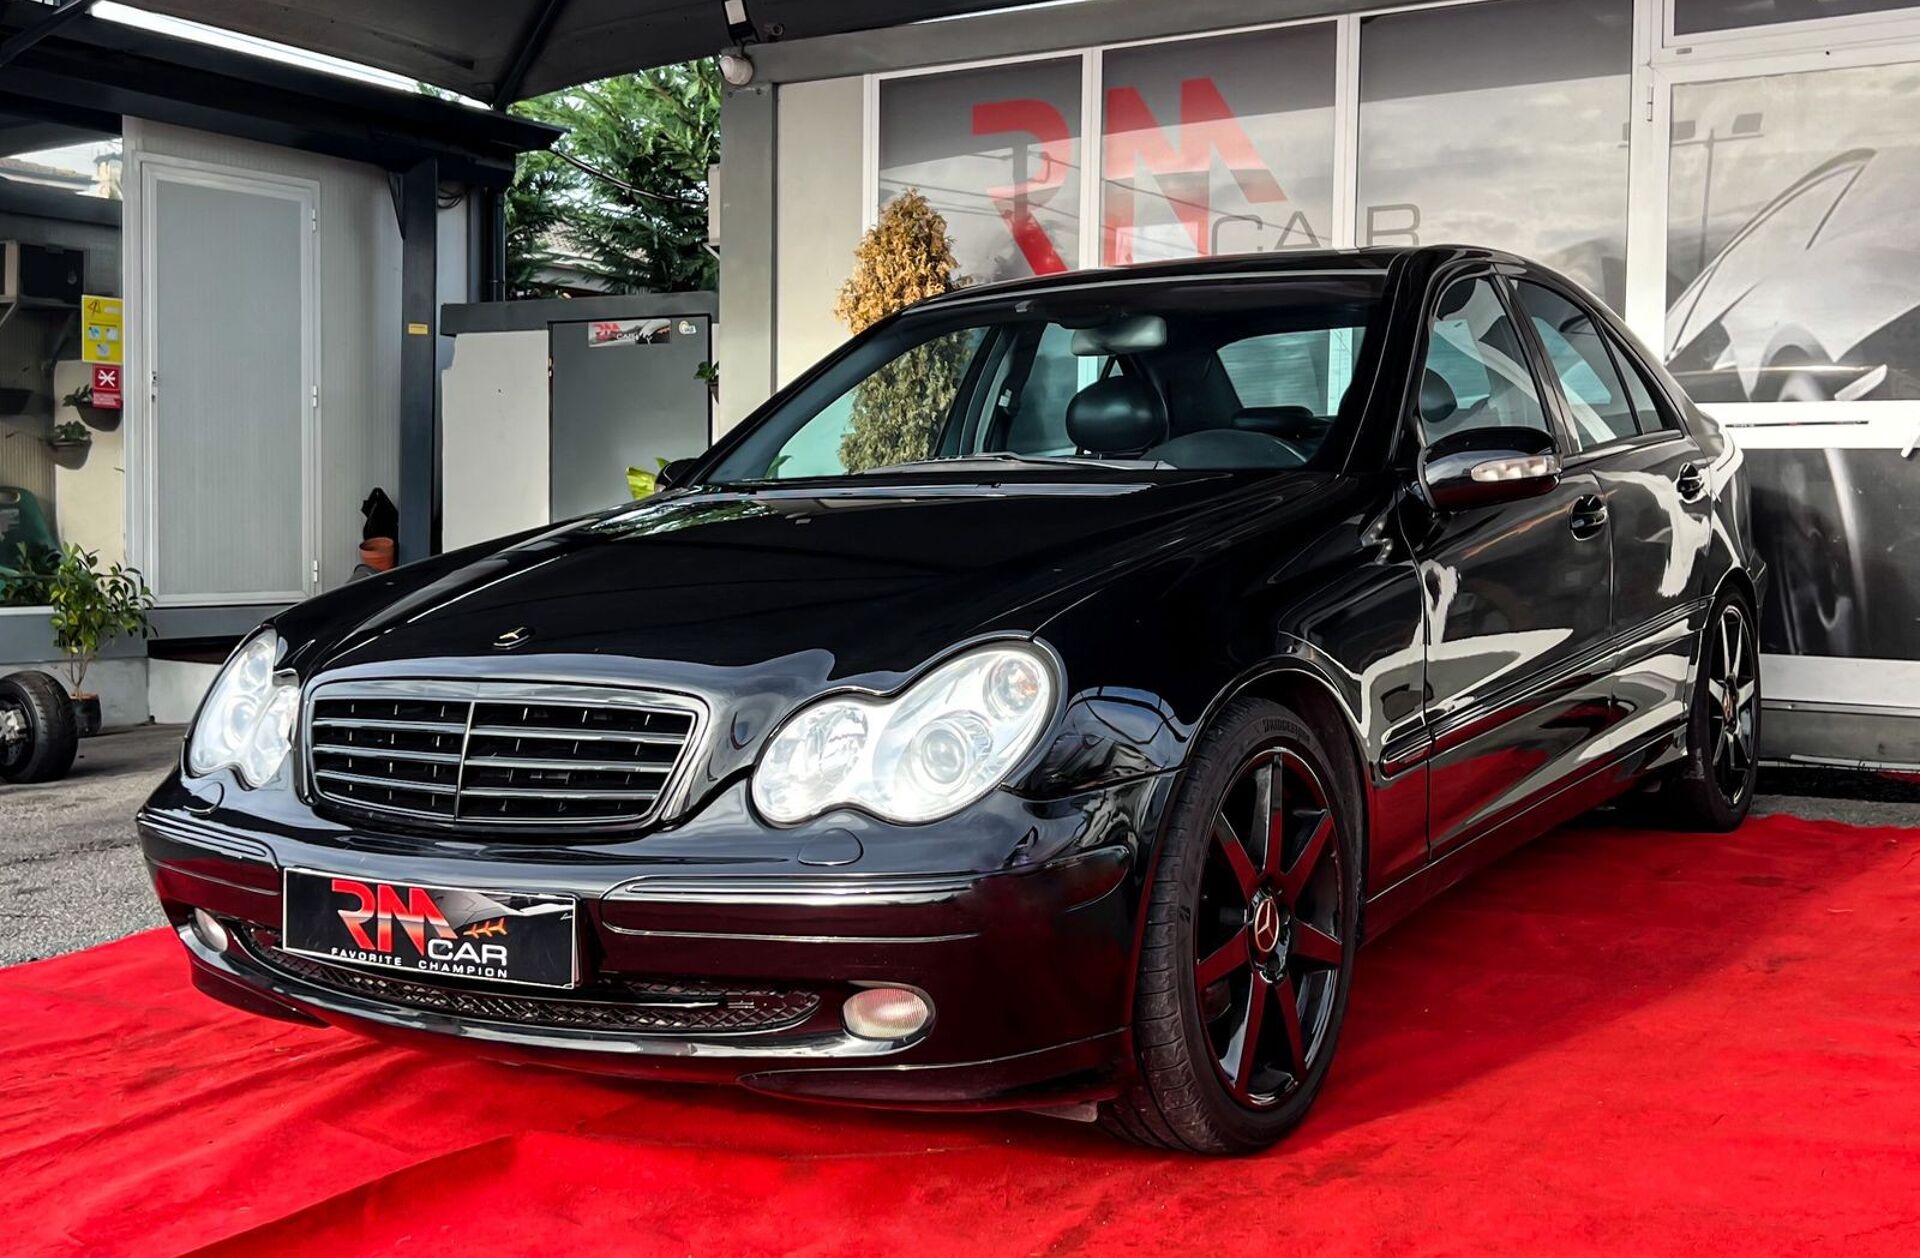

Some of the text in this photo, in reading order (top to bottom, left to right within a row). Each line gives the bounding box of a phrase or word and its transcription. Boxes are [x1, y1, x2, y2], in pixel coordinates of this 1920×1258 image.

[972, 77, 1288, 275] RM
[1212, 203, 1421, 256] CAR
[331, 879, 458, 956] RM
[331, 947, 508, 978] FAVORITE CHAMPION
[427, 939, 508, 966] CAR
